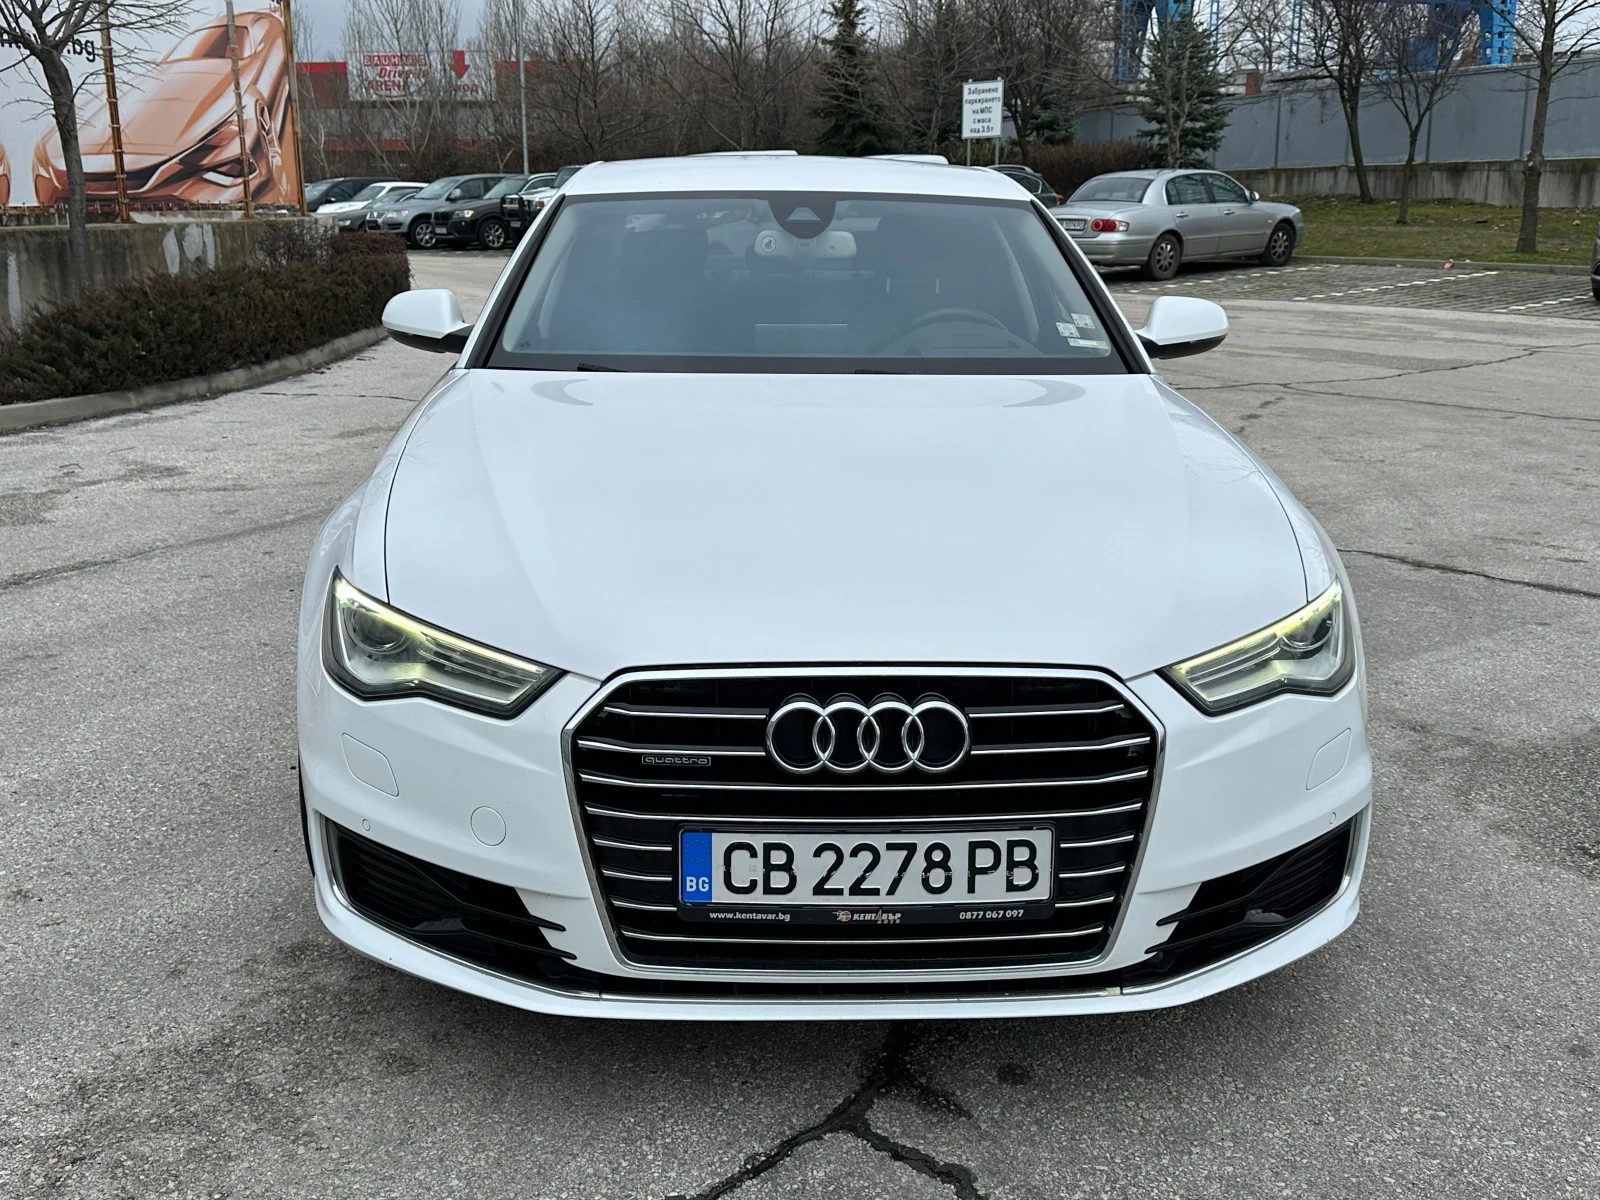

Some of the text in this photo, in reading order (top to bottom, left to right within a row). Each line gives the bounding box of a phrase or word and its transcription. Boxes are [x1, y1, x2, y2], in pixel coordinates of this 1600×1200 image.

[968, 88, 998, 96] Забранено
[964, 97, 1000, 106] паркирането
[723, 839, 1039, 896] CB 2278 PB
[686, 876, 710, 892] BG
[709, 911, 791, 922] www.kentavar.bg
[959, 909, 1024, 920] 0877 067 097
